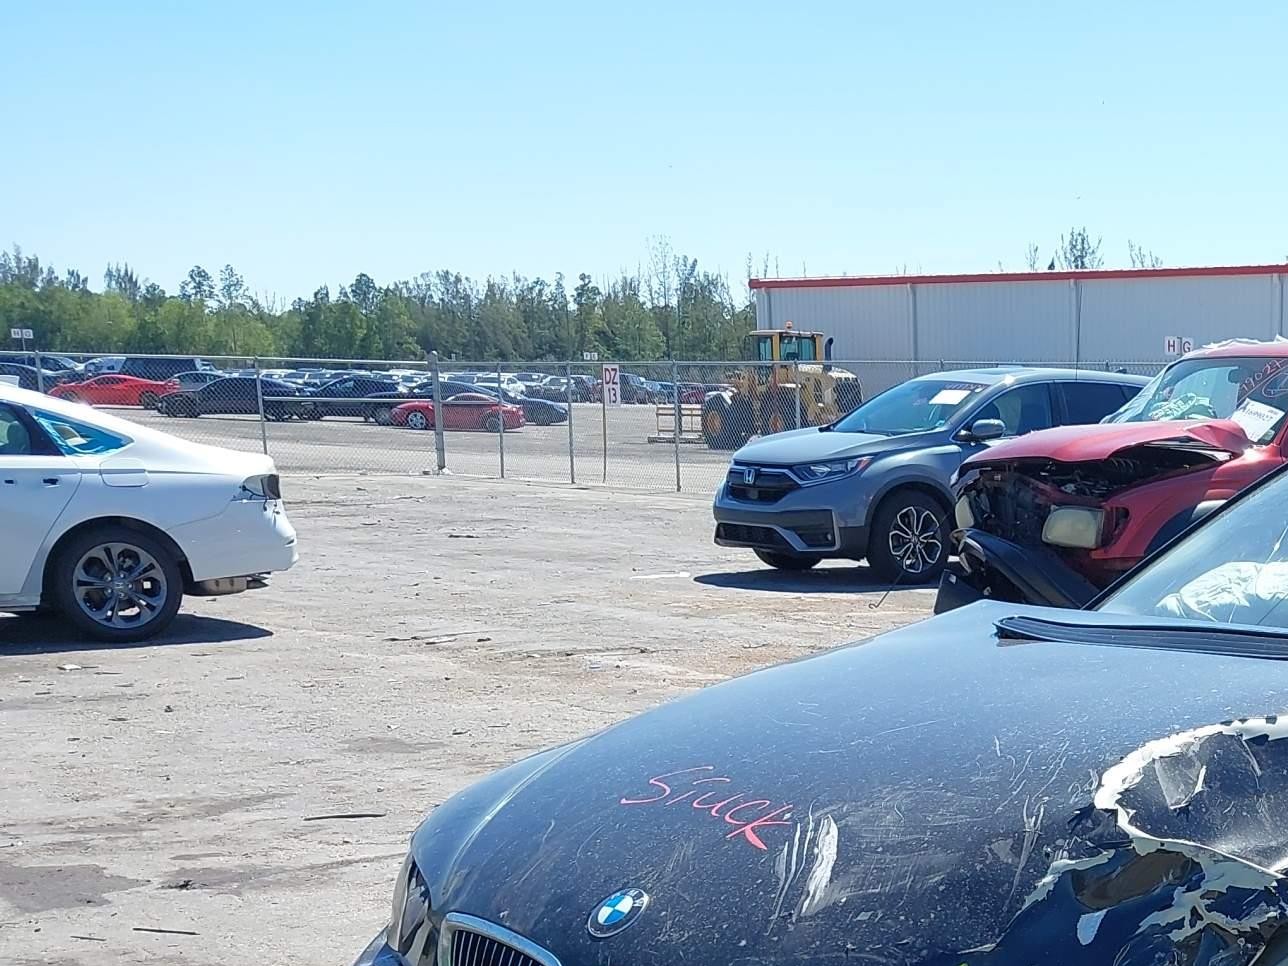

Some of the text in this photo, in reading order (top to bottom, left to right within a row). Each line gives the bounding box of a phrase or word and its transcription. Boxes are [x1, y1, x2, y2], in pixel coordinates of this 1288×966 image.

[1167, 339, 1192, 353] H G
[603, 367, 619, 385] DZ
[607, 387, 618, 404] 13
